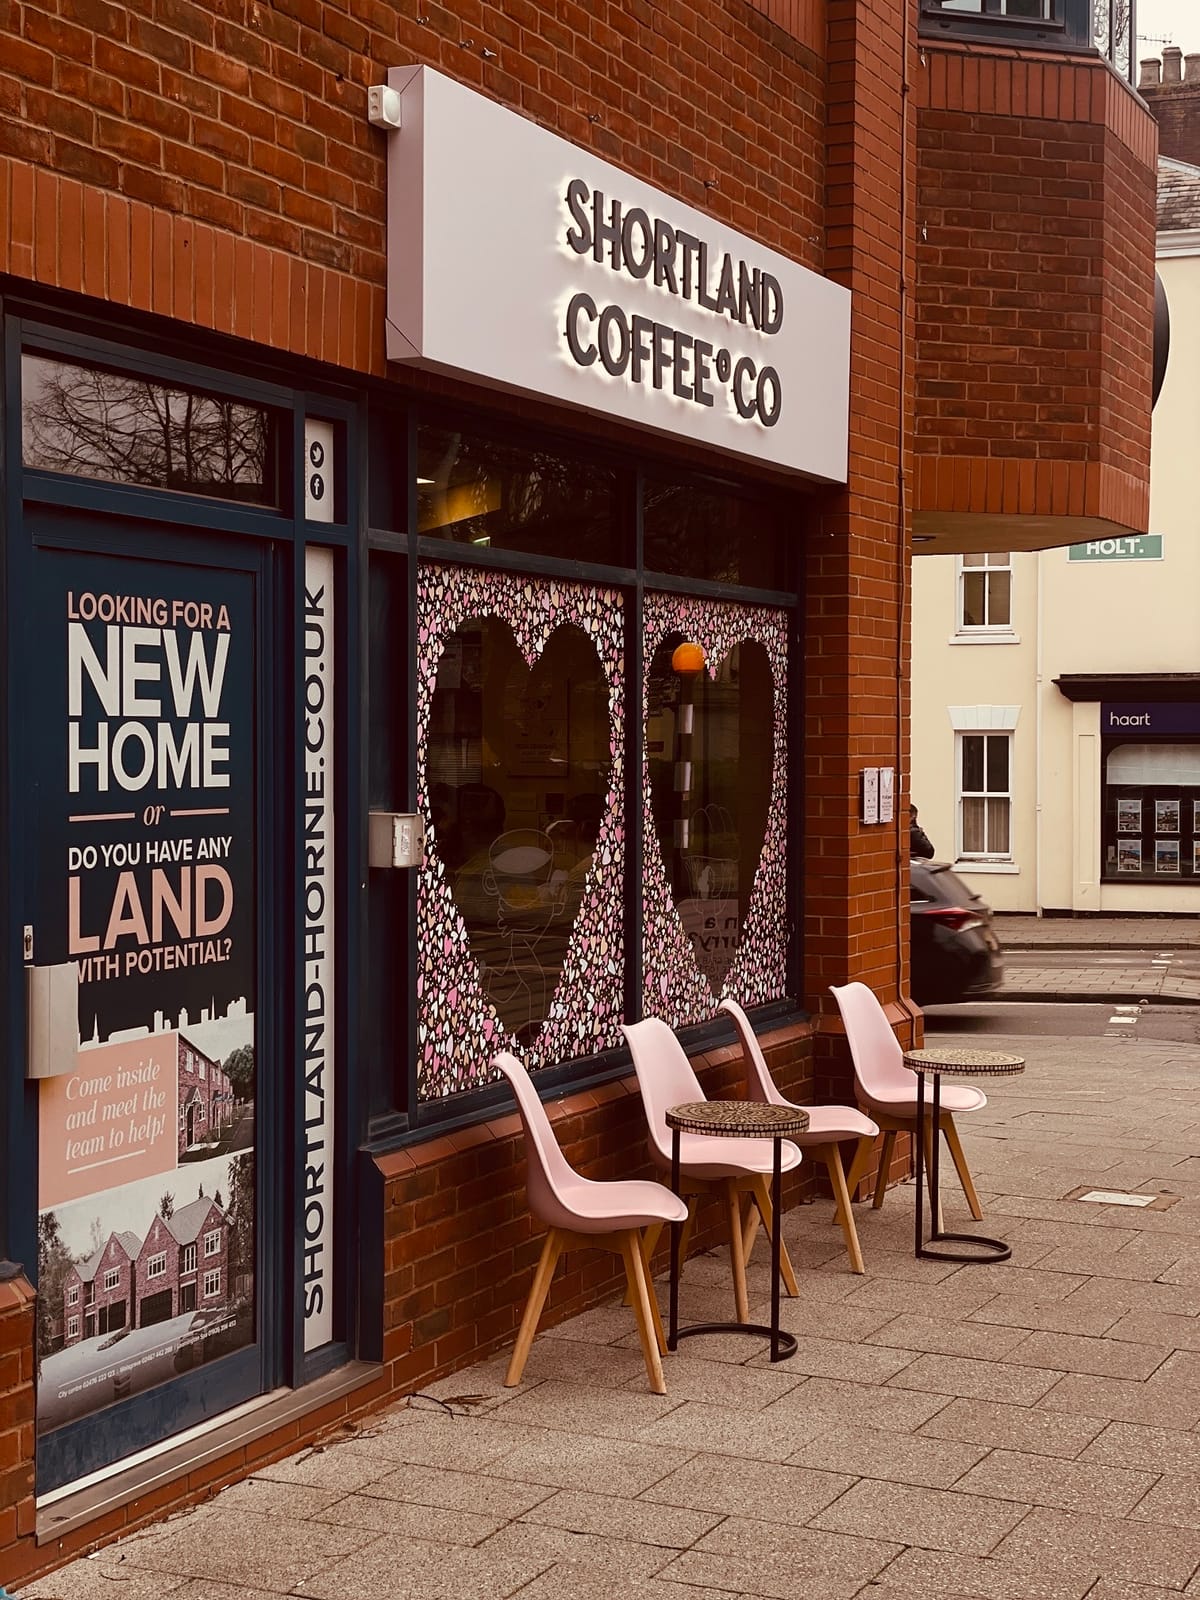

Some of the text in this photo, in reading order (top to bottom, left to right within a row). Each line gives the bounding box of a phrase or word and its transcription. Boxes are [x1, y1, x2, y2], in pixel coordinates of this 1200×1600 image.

[565, 179, 783, 334] SHORTLAND
[68, 591, 231, 631] LOOKING FOR A
[68, 622, 231, 719] NEW
[1109, 711, 1151, 727] haart
[68, 722, 231, 793] HOME
[143, 804, 166, 827] or
[68, 836, 233, 871] DO YOU HAVE ANY
[68, 864, 234, 955] LAND
[125, 938, 232, 977] POTENTIAL?
[304, 585, 325, 1319] SHORTLAND-HORNE.CO.UK
[66, 1058, 161, 1101] Come inside
[66, 1087, 166, 1131] and meet the
[65, 1114, 166, 1161] team to help!
